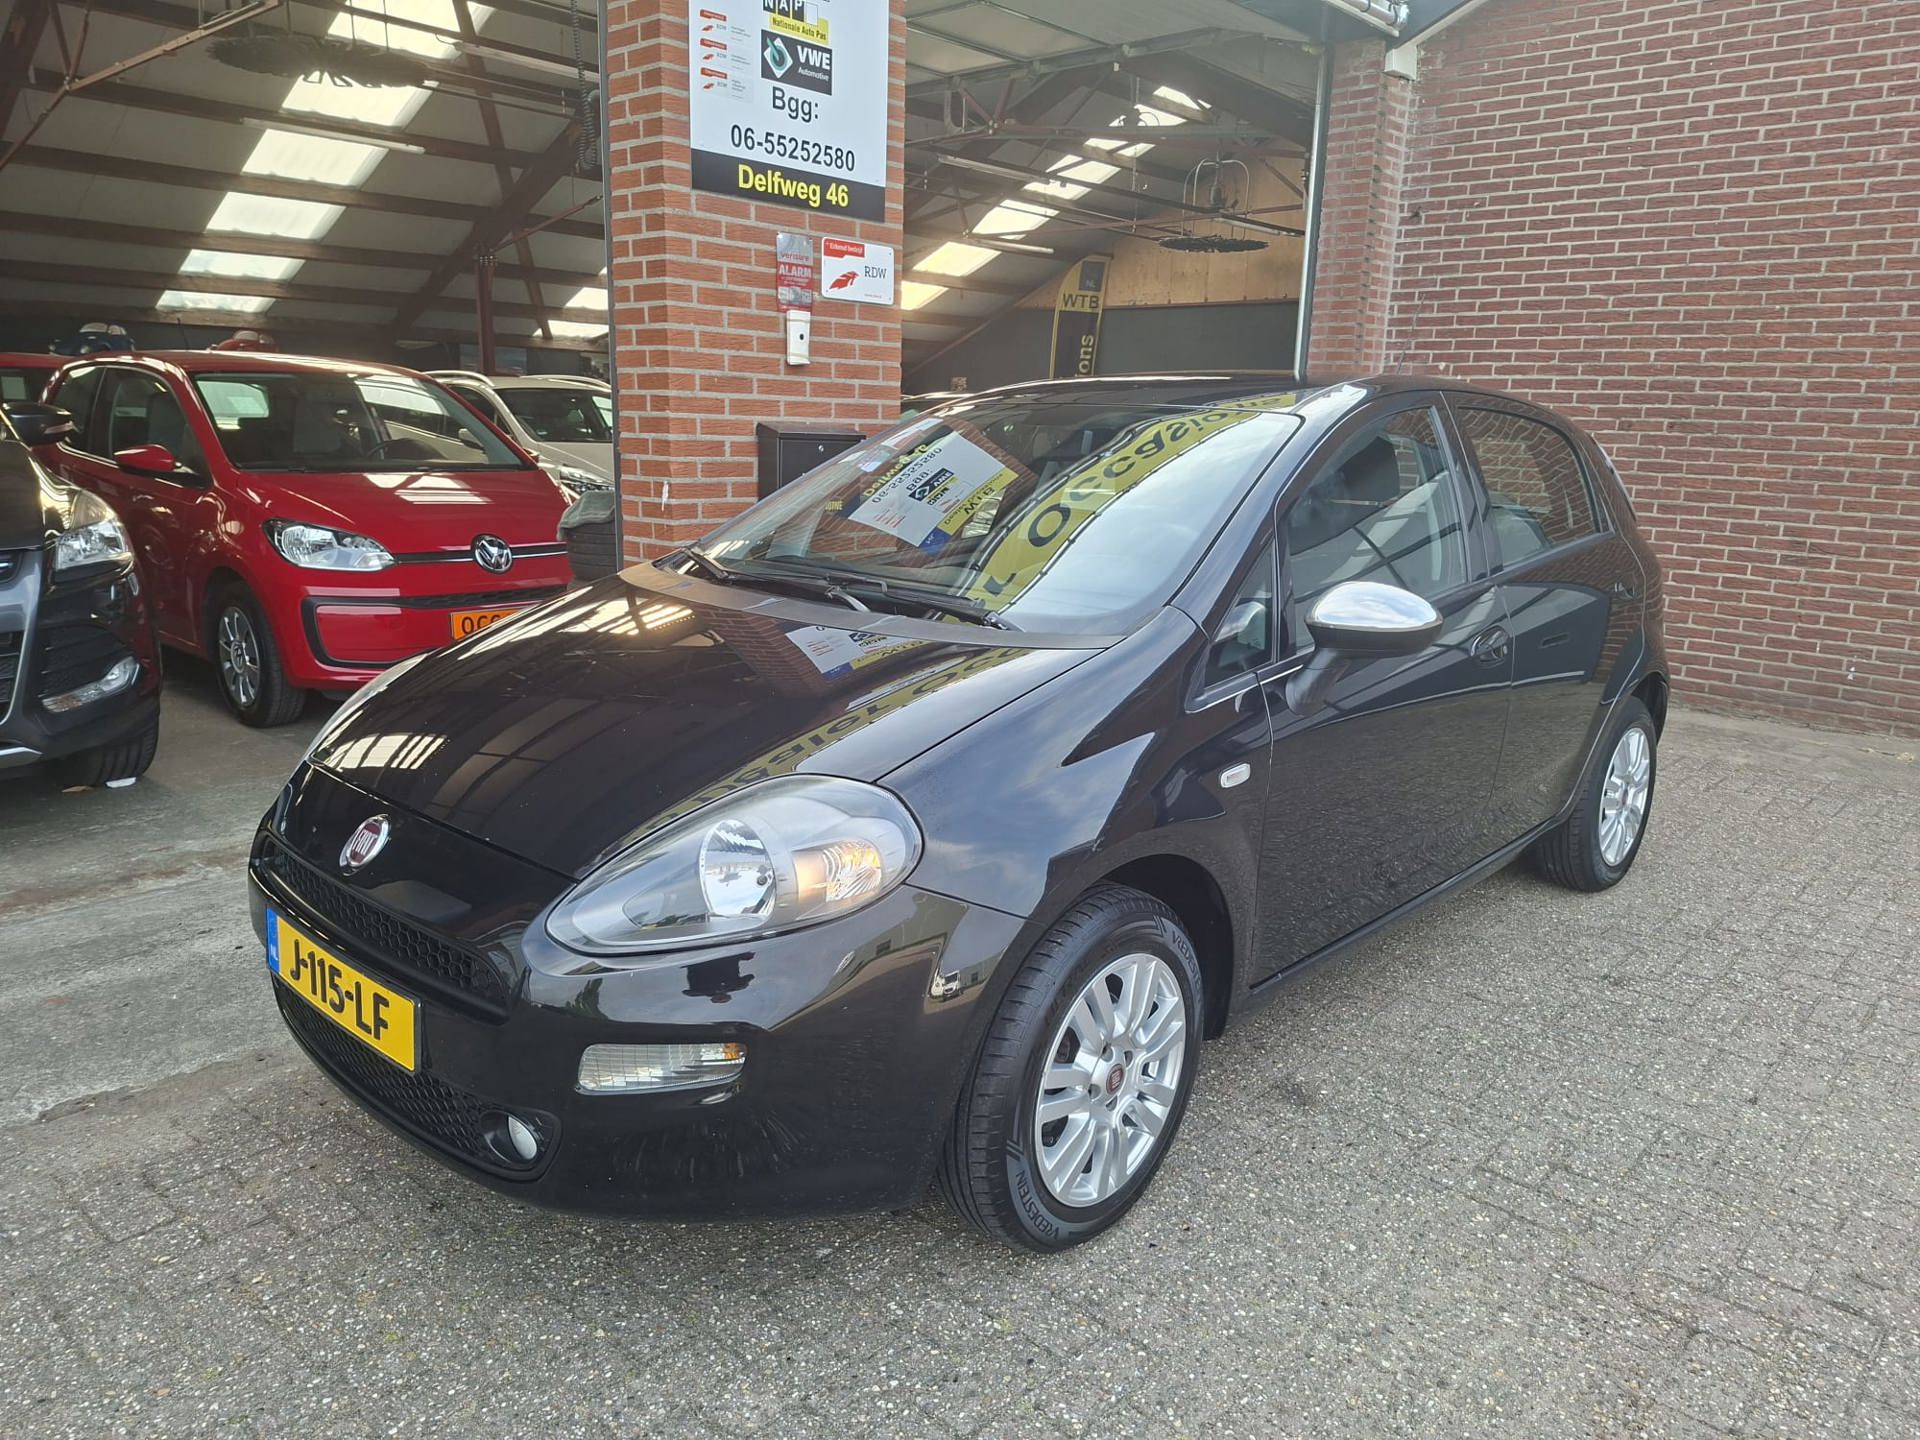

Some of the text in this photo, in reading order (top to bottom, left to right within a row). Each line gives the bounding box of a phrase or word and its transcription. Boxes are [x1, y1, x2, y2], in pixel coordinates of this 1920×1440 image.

[772, 17, 827, 41] Nationale Auto Pas
[797, 45, 831, 70] VWE
[798, 67, 830, 82] Automotive
[772, 86, 819, 123] Bgg:
[730, 124, 856, 172] 06-55252580
[738, 164, 849, 208] Delfweg 46
[779, 263, 812, 279] ALARM
[864, 265, 887, 279] RDW
[1063, 293, 1099, 309] WTB
[289, 938, 390, 1041] J-115-LF
